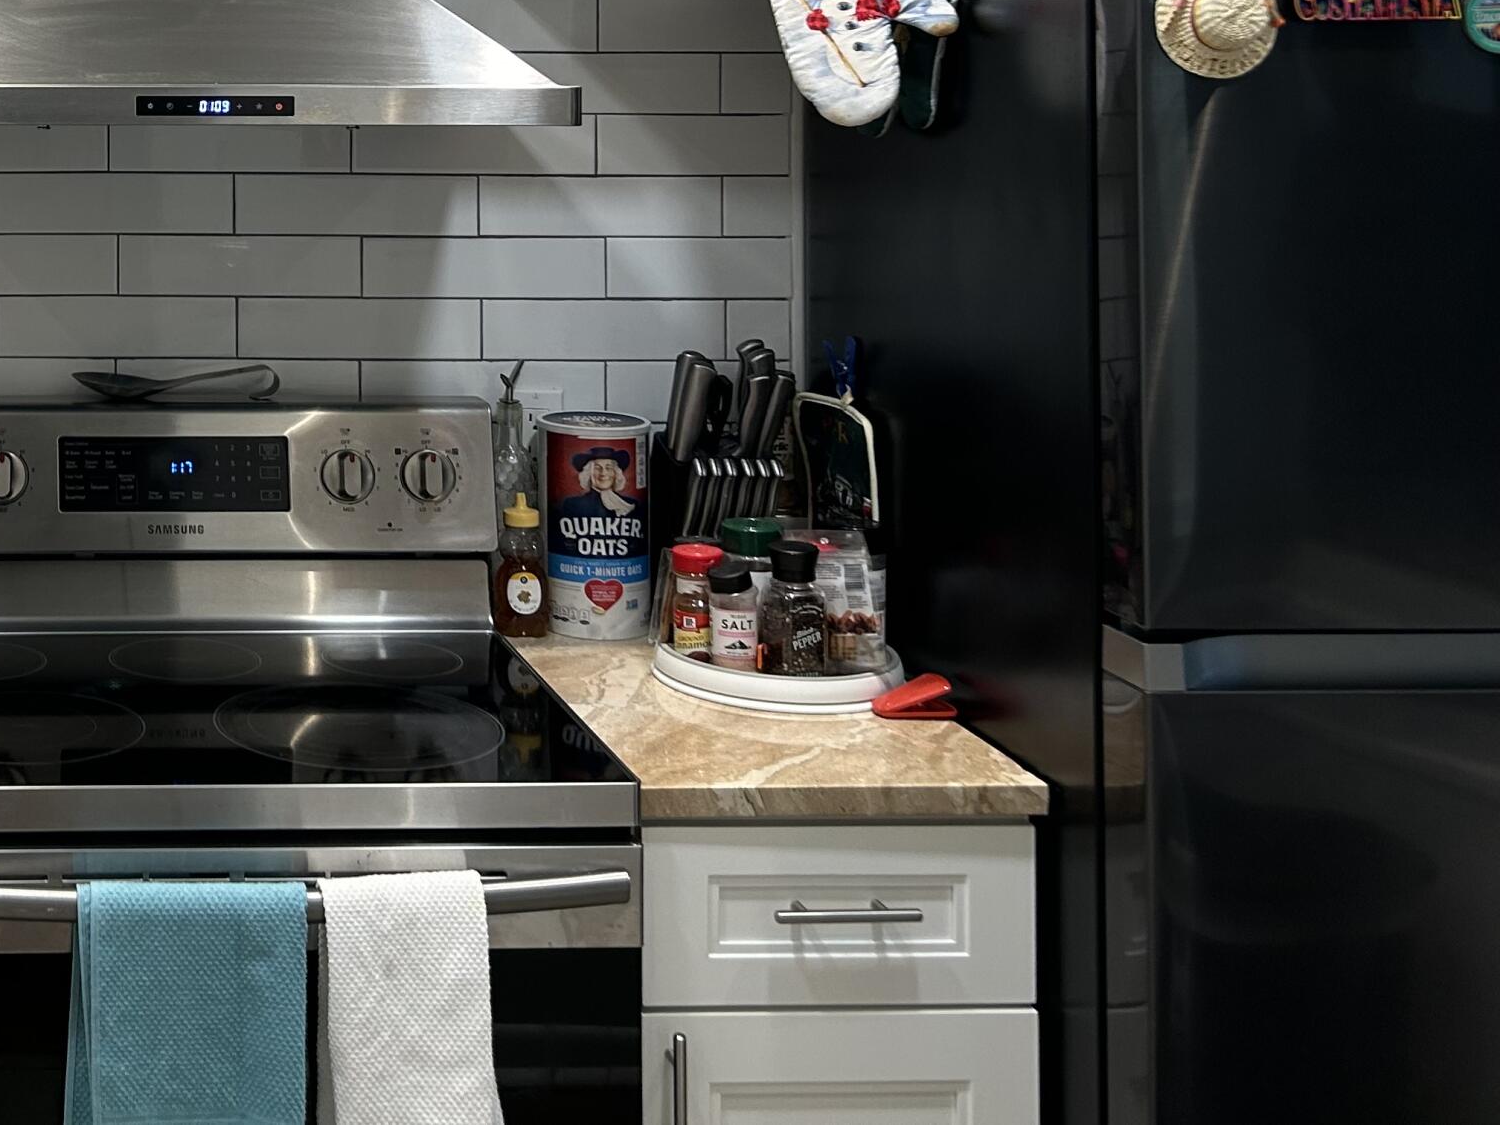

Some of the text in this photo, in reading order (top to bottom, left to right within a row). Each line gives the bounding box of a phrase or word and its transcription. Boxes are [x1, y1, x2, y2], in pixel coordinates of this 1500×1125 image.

[147, 524, 205, 535] SAMSUNG
[559, 516, 642, 539] QUAKER
[577, 538, 629, 556] OATS
[560, 562, 585, 576] QUICK
[587, 564, 626, 577] 1-MINUTE
[721, 618, 754, 631] SALT
[792, 631, 822, 652] PEPPER
